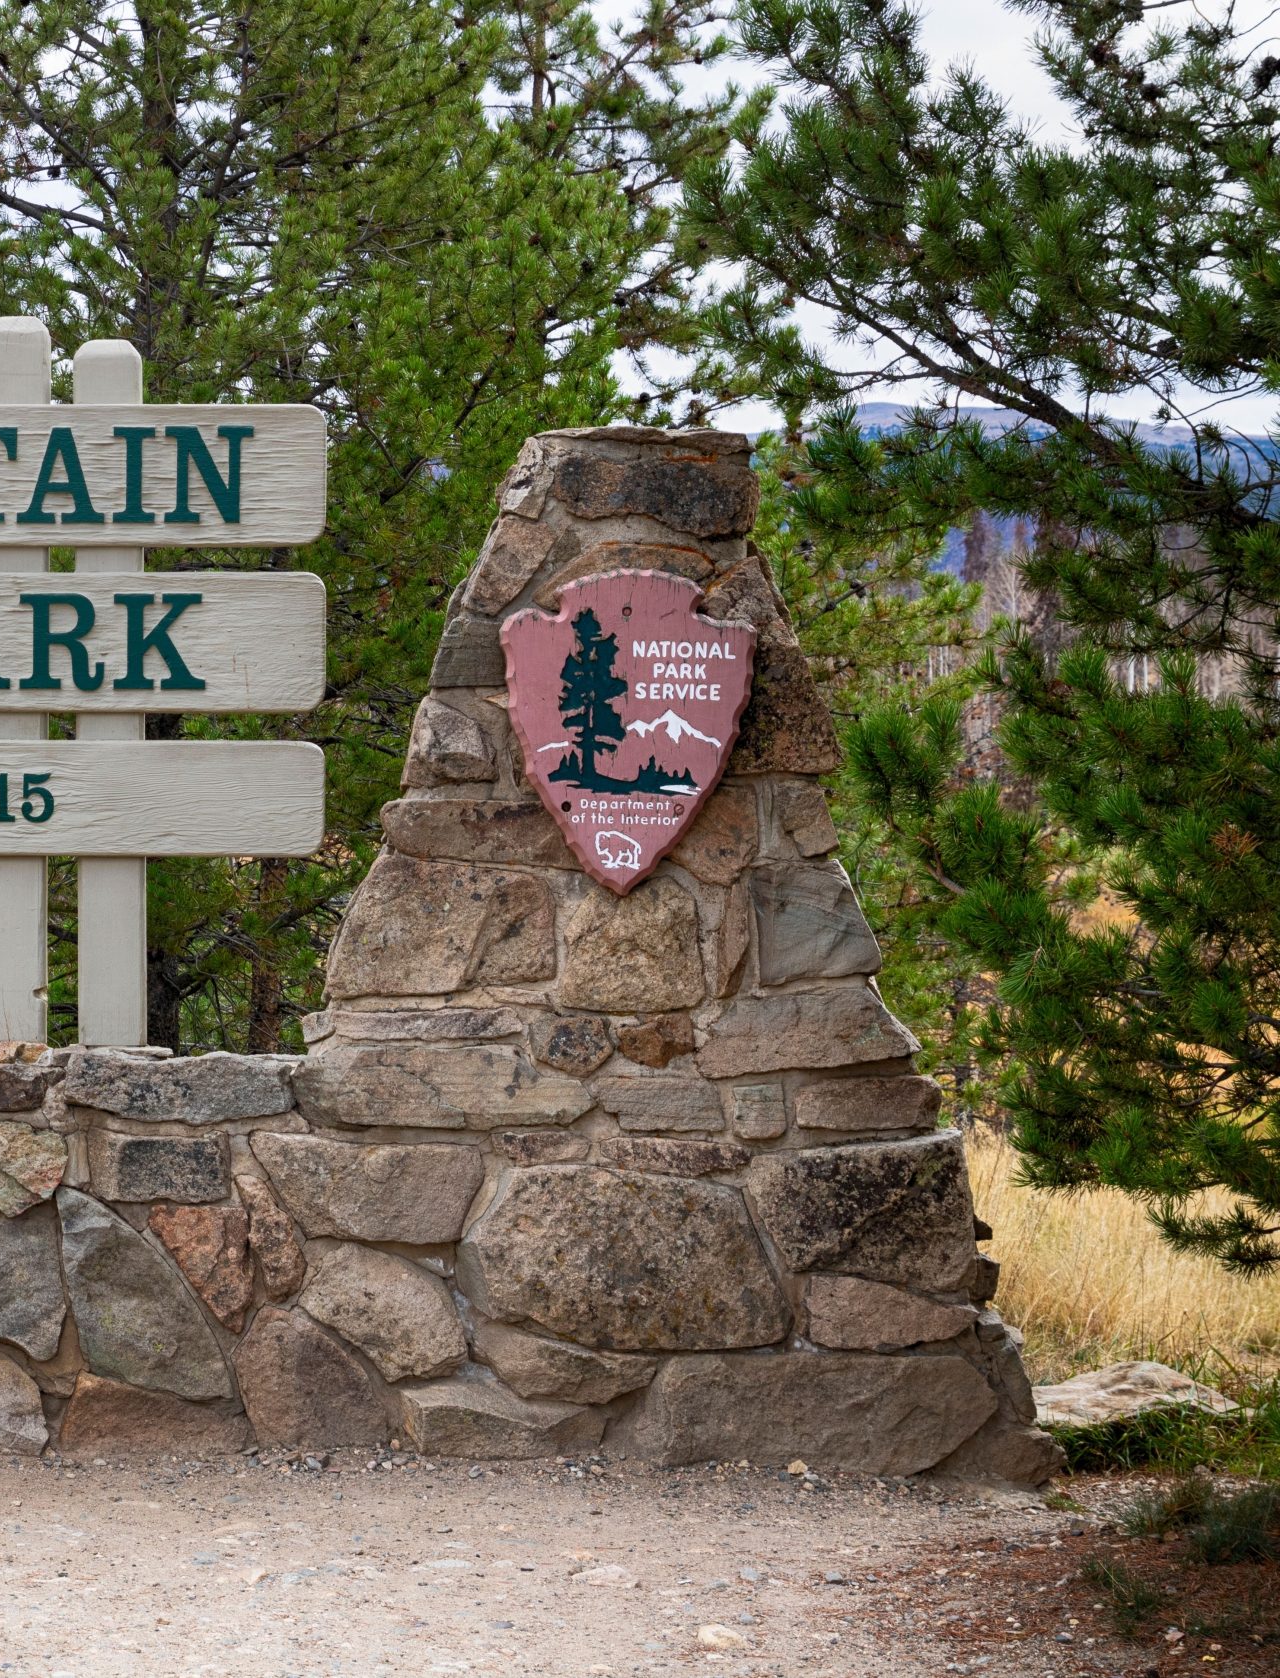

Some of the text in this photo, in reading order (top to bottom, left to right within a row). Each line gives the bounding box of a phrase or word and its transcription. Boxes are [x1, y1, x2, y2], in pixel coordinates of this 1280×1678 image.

[632, 640, 736, 659] NATIONAL
[653, 662, 707, 679] PARK
[635, 682, 721, 701] SERVICE
[580, 798, 670, 811] Department
[571, 813, 679, 826] of the Interior
